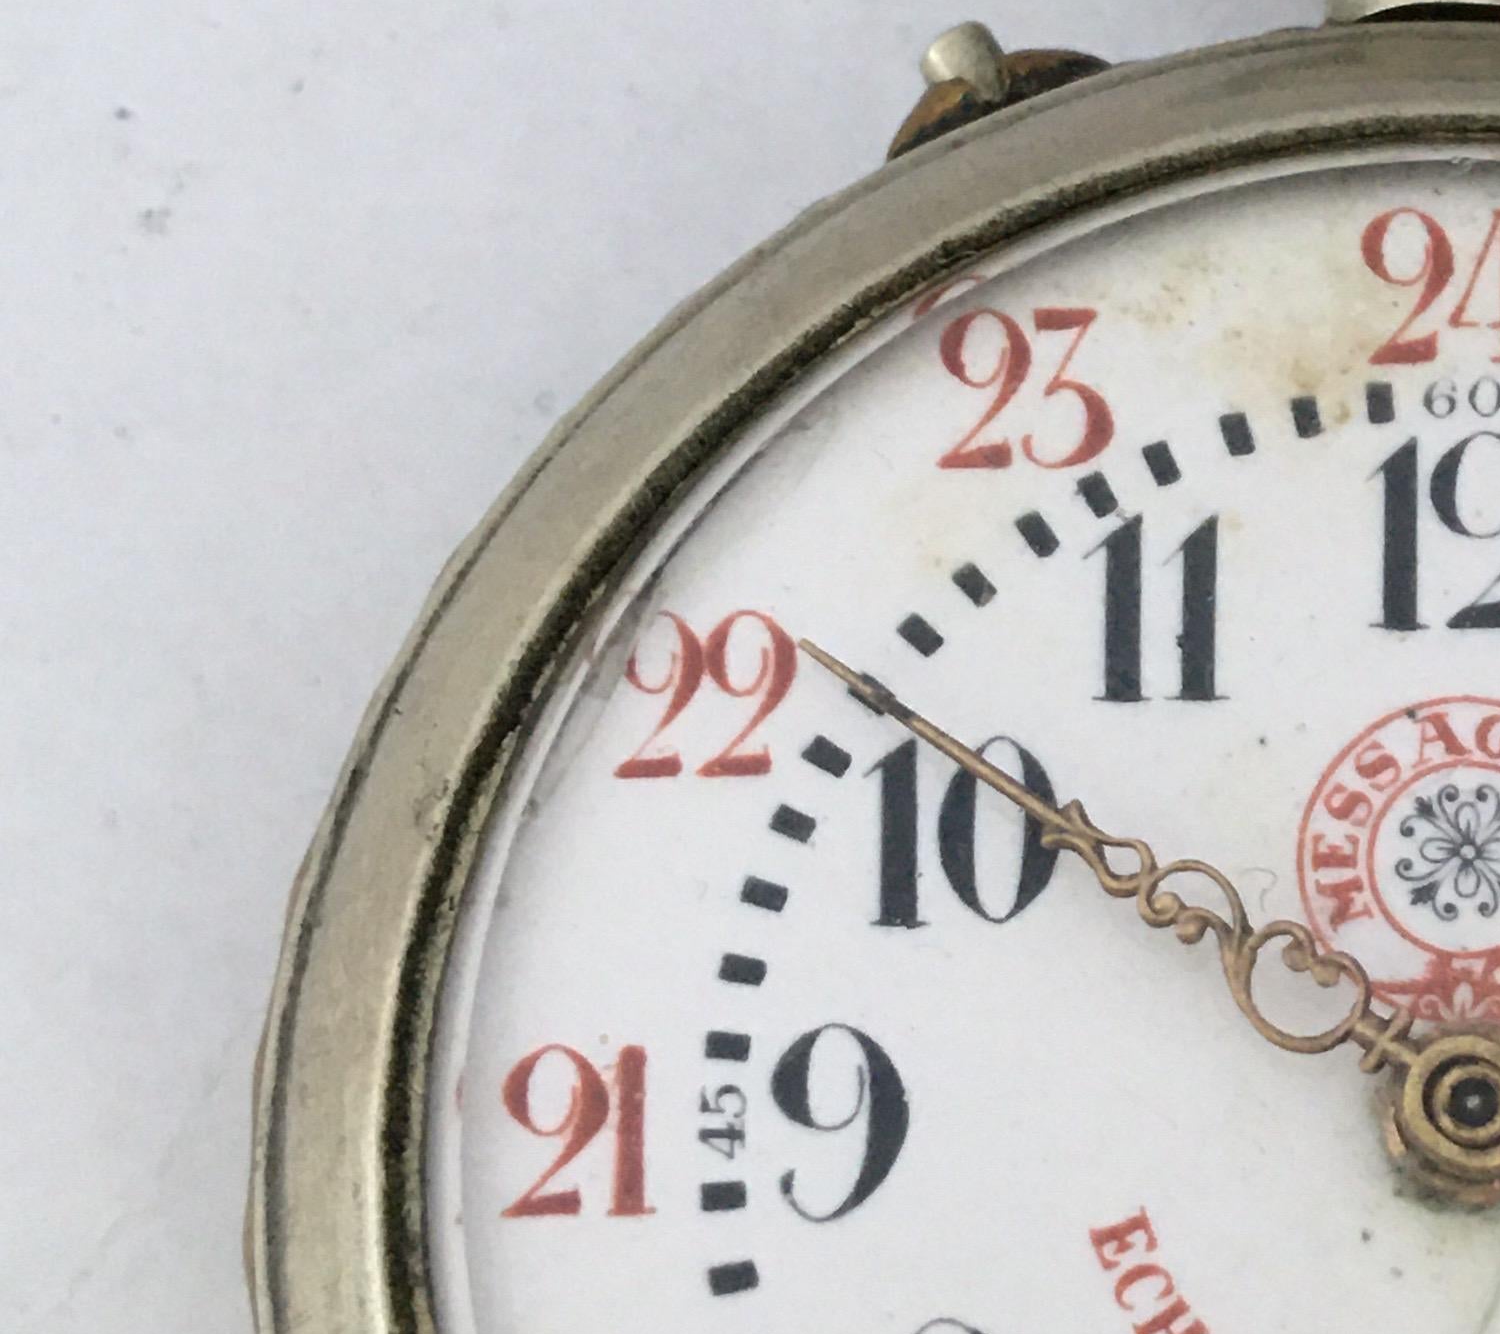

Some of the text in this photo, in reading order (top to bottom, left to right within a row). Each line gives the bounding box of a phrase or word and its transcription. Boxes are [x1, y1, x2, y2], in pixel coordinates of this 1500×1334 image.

[936, 306, 1116, 471] 23
[612, 609, 799, 780] 22
[1081, 513, 1232, 704] 11
[862, 734, 1062, 930] 10
[500, 1042, 658, 1220] 21
[698, 1083, 748, 1160] 45
[769, 1022, 912, 1223] 9
